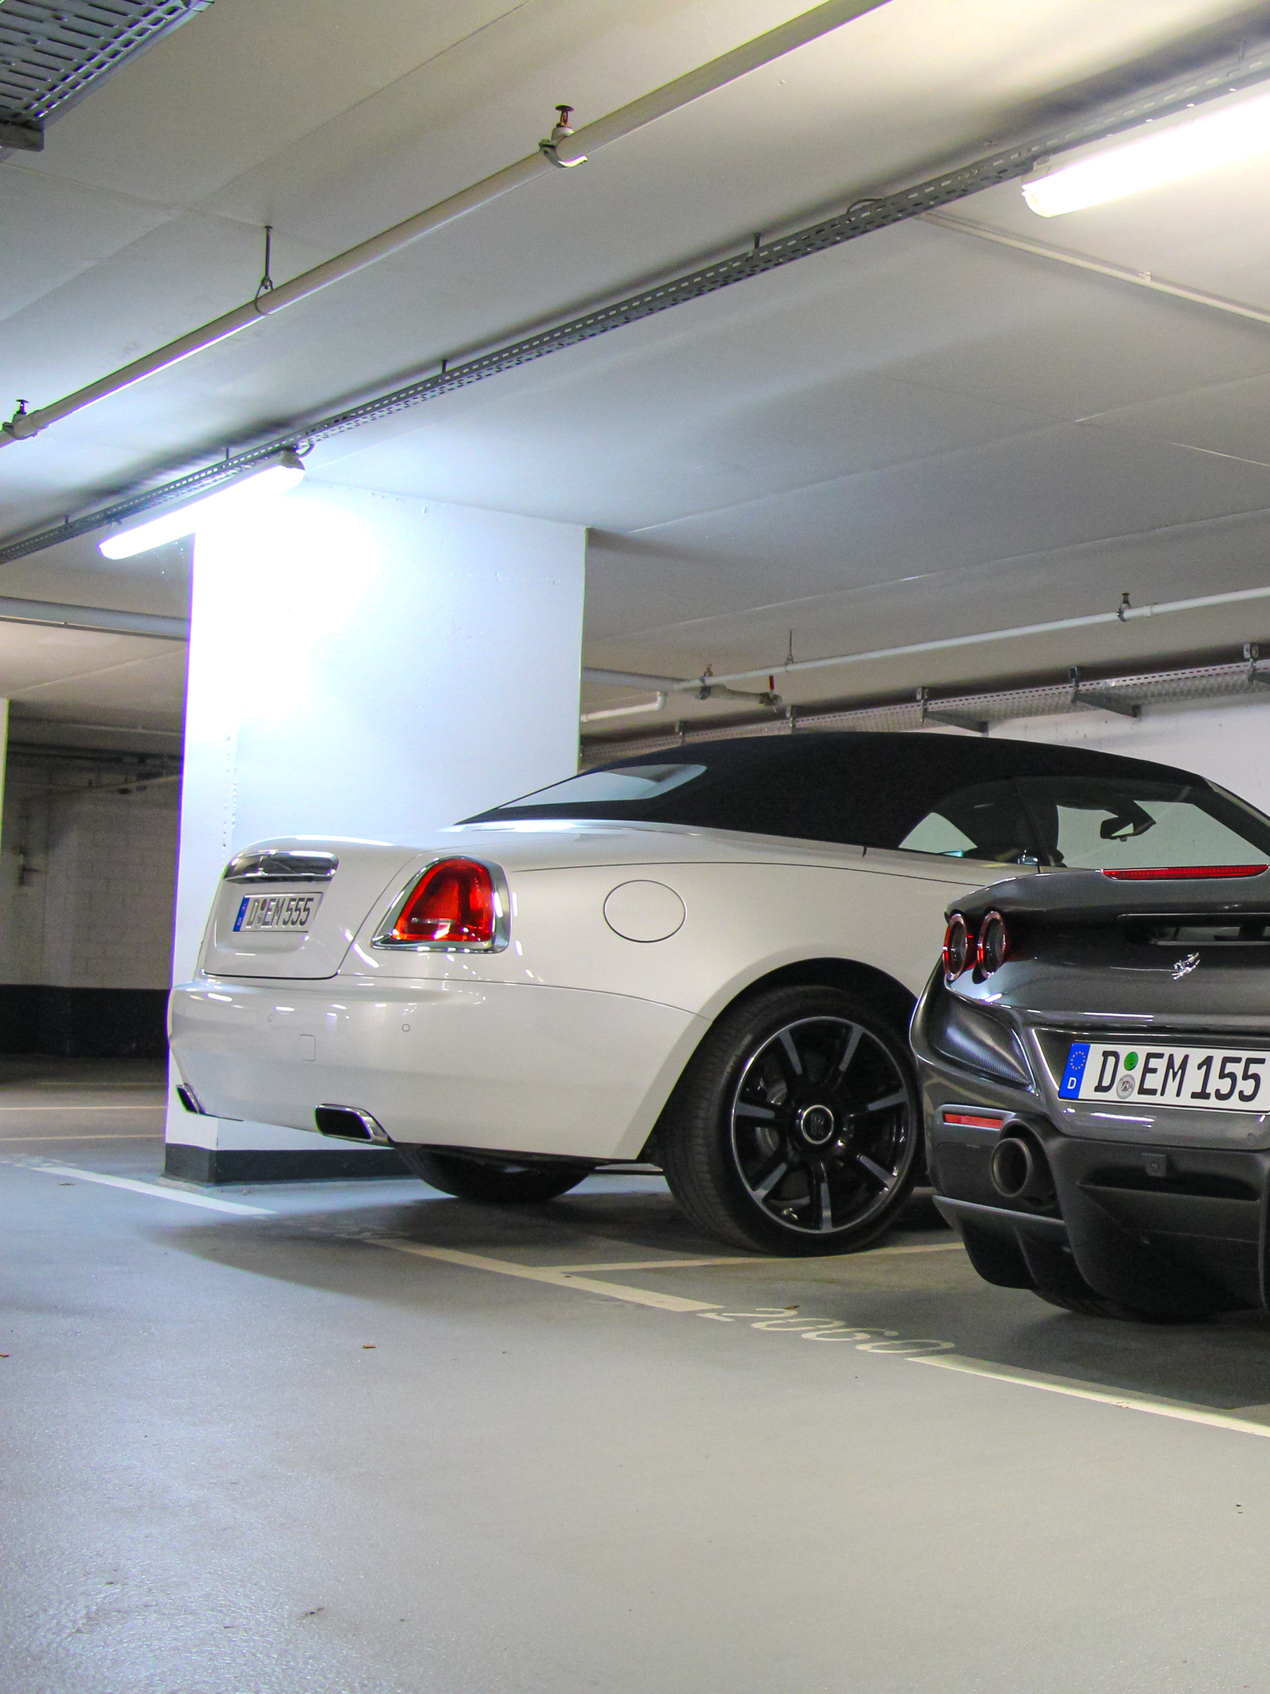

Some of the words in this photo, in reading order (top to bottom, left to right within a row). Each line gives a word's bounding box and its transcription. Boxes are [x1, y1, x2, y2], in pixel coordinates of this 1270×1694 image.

[282, 897, 315, 926] 555
[1066, 1076, 1078, 1090] D
[1094, 1050, 1121, 1093] D
[1137, 1051, 1190, 1098] EM
[1190, 1054, 1267, 1103] 155
